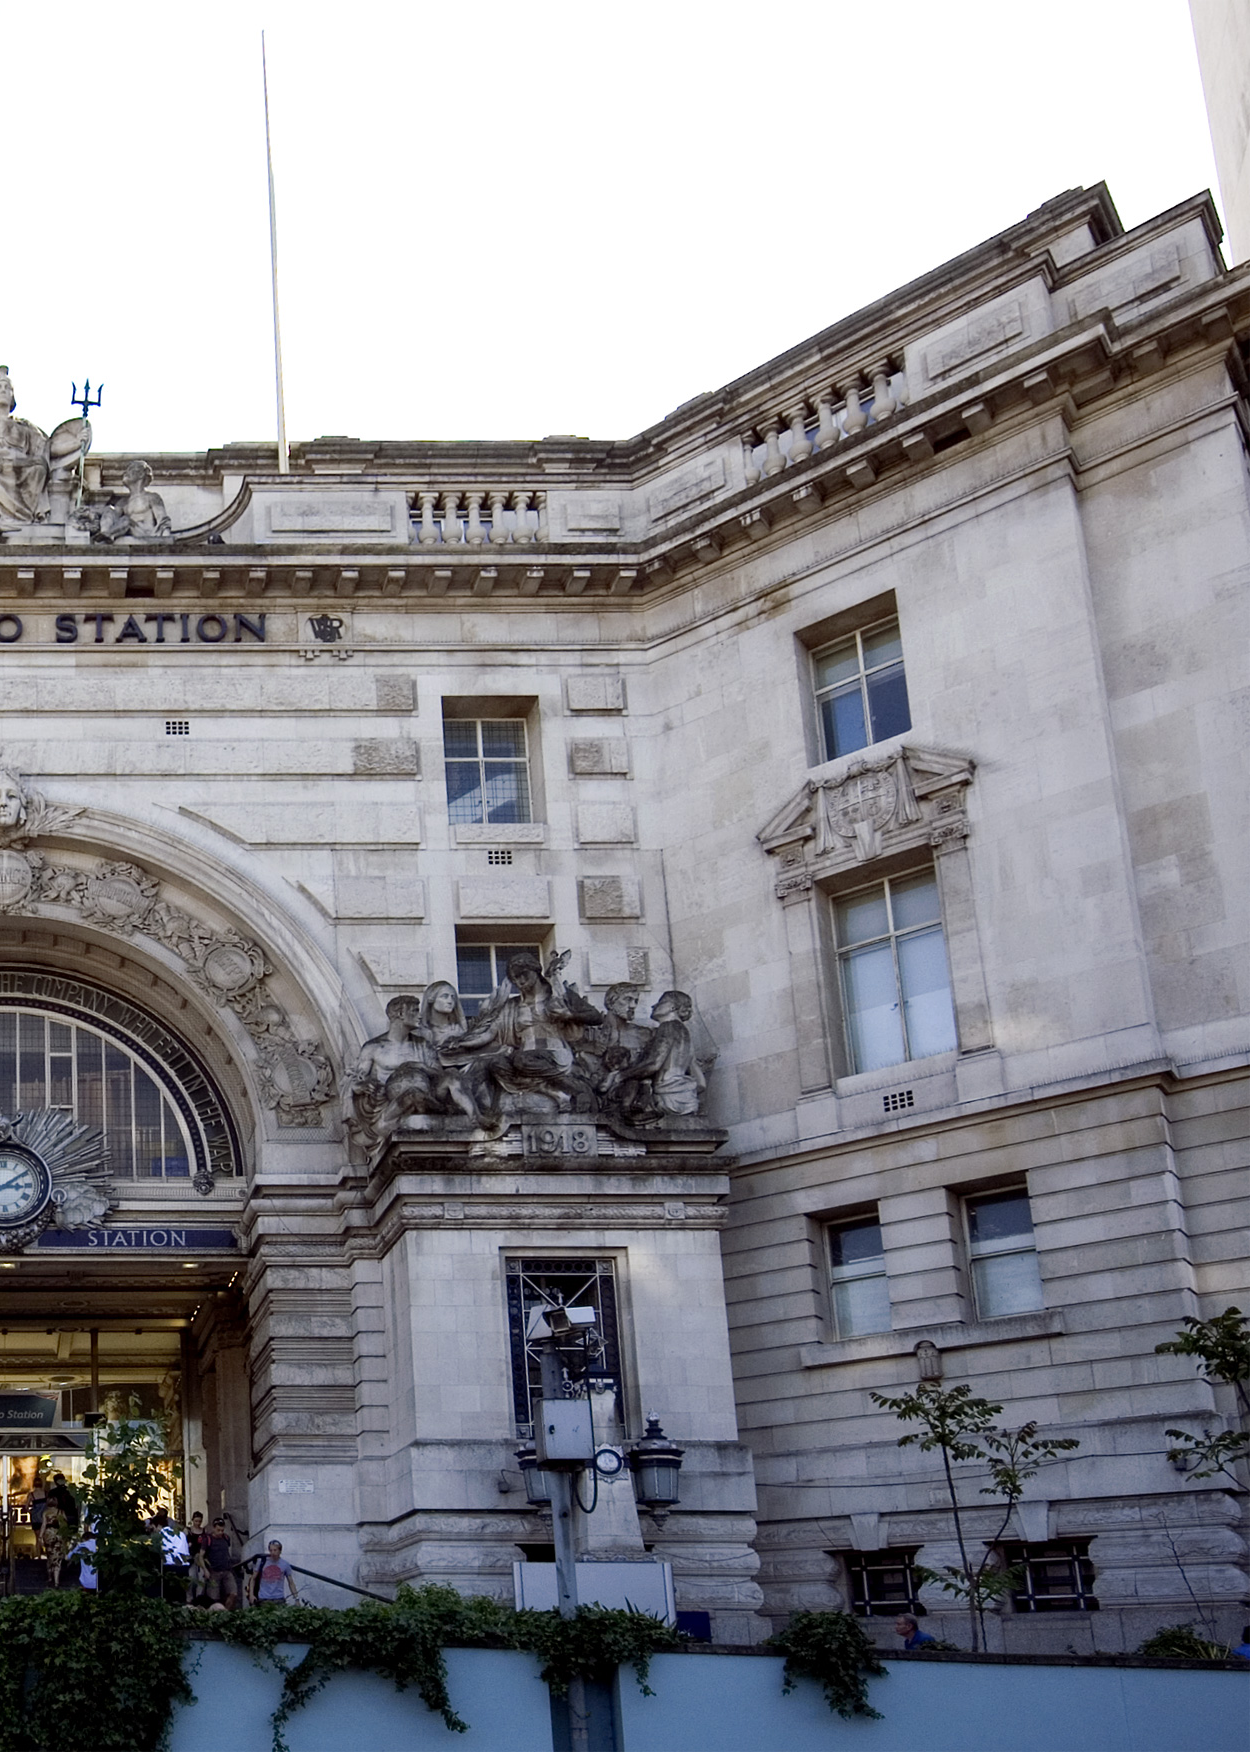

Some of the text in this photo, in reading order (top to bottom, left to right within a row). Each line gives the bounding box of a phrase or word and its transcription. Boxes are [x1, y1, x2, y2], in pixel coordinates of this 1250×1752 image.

[56, 613, 268, 643] STATION
[32, 976, 114, 1012] COMPANY
[118, 1006, 157, 1040] WHO
[152, 1035, 196, 1076] FELL
[182, 1071, 207, 1096] IN
[196, 1090, 224, 1132] THE
[208, 1131, 234, 1173] WAR
[529, 1130, 590, 1154] 1918
[88, 1230, 186, 1247] STATION
[6, 1409, 44, 1419] Station
